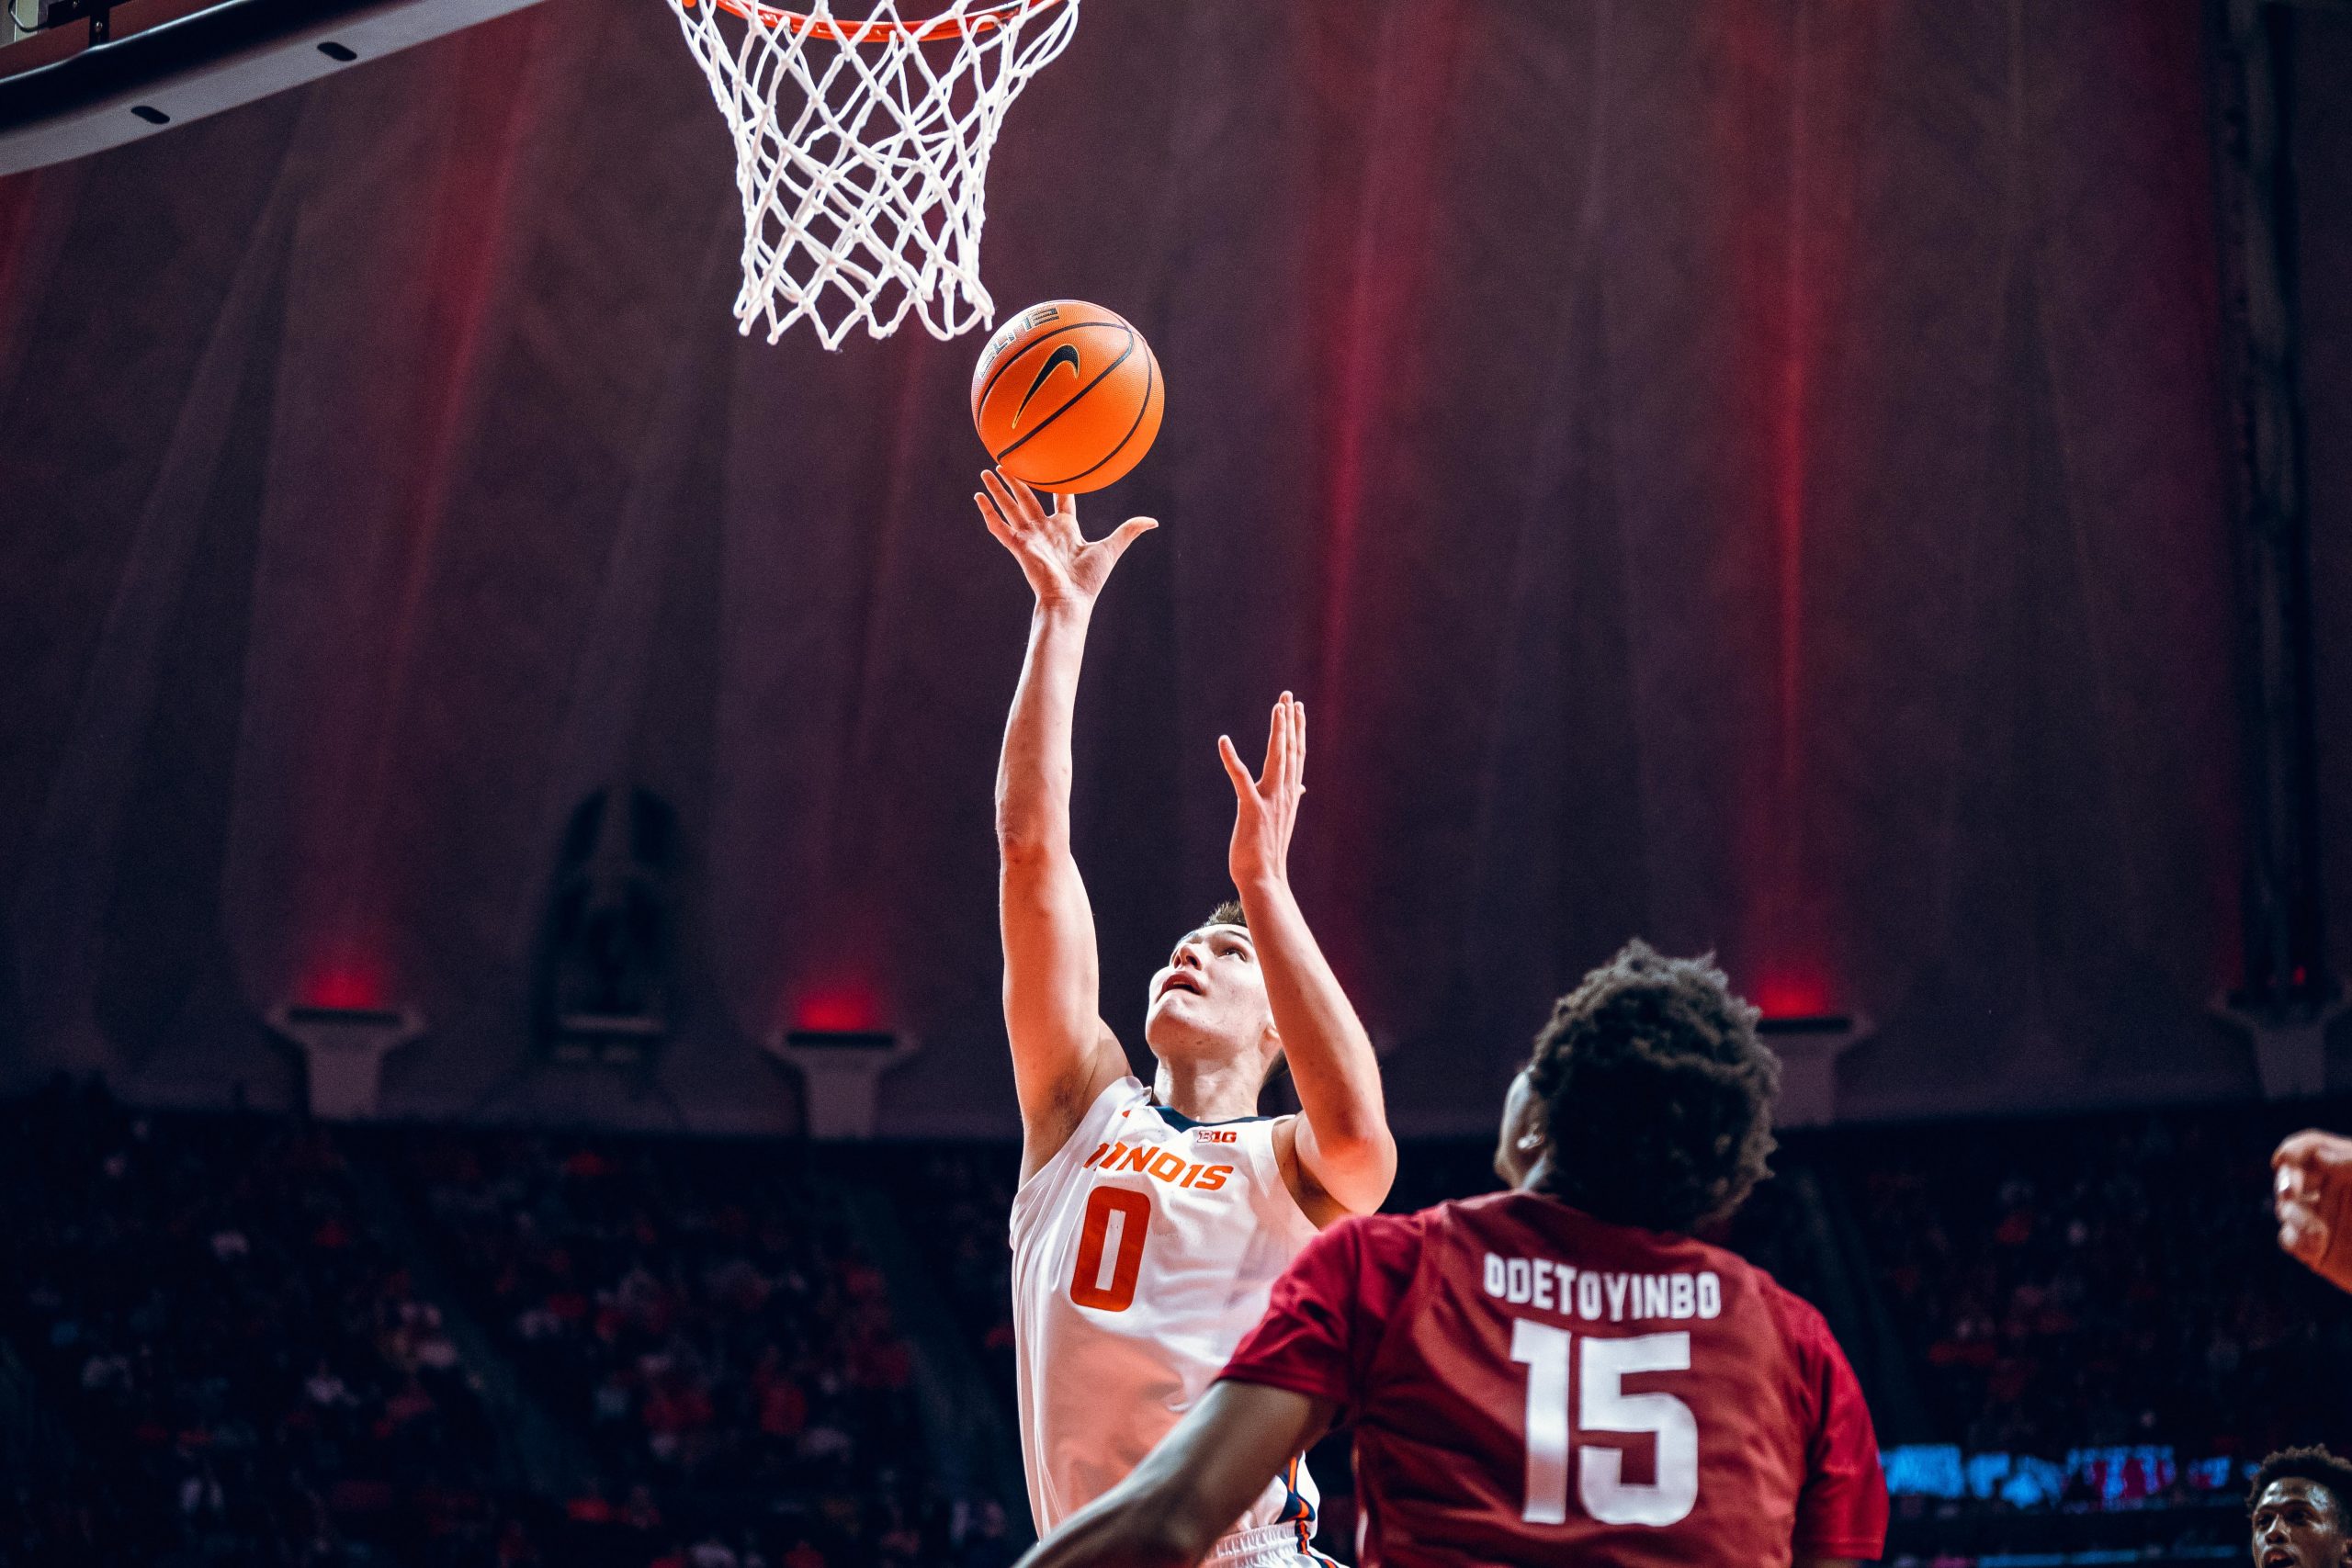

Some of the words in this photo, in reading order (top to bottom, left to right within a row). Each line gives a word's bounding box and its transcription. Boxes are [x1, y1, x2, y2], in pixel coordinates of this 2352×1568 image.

[1083, 1142, 1234, 1190] IINOIS
[1069, 1185, 1151, 1313] 0
[1483, 1250, 1722, 1323] ODETOYINBO
[1510, 1317, 1699, 1528] 15
